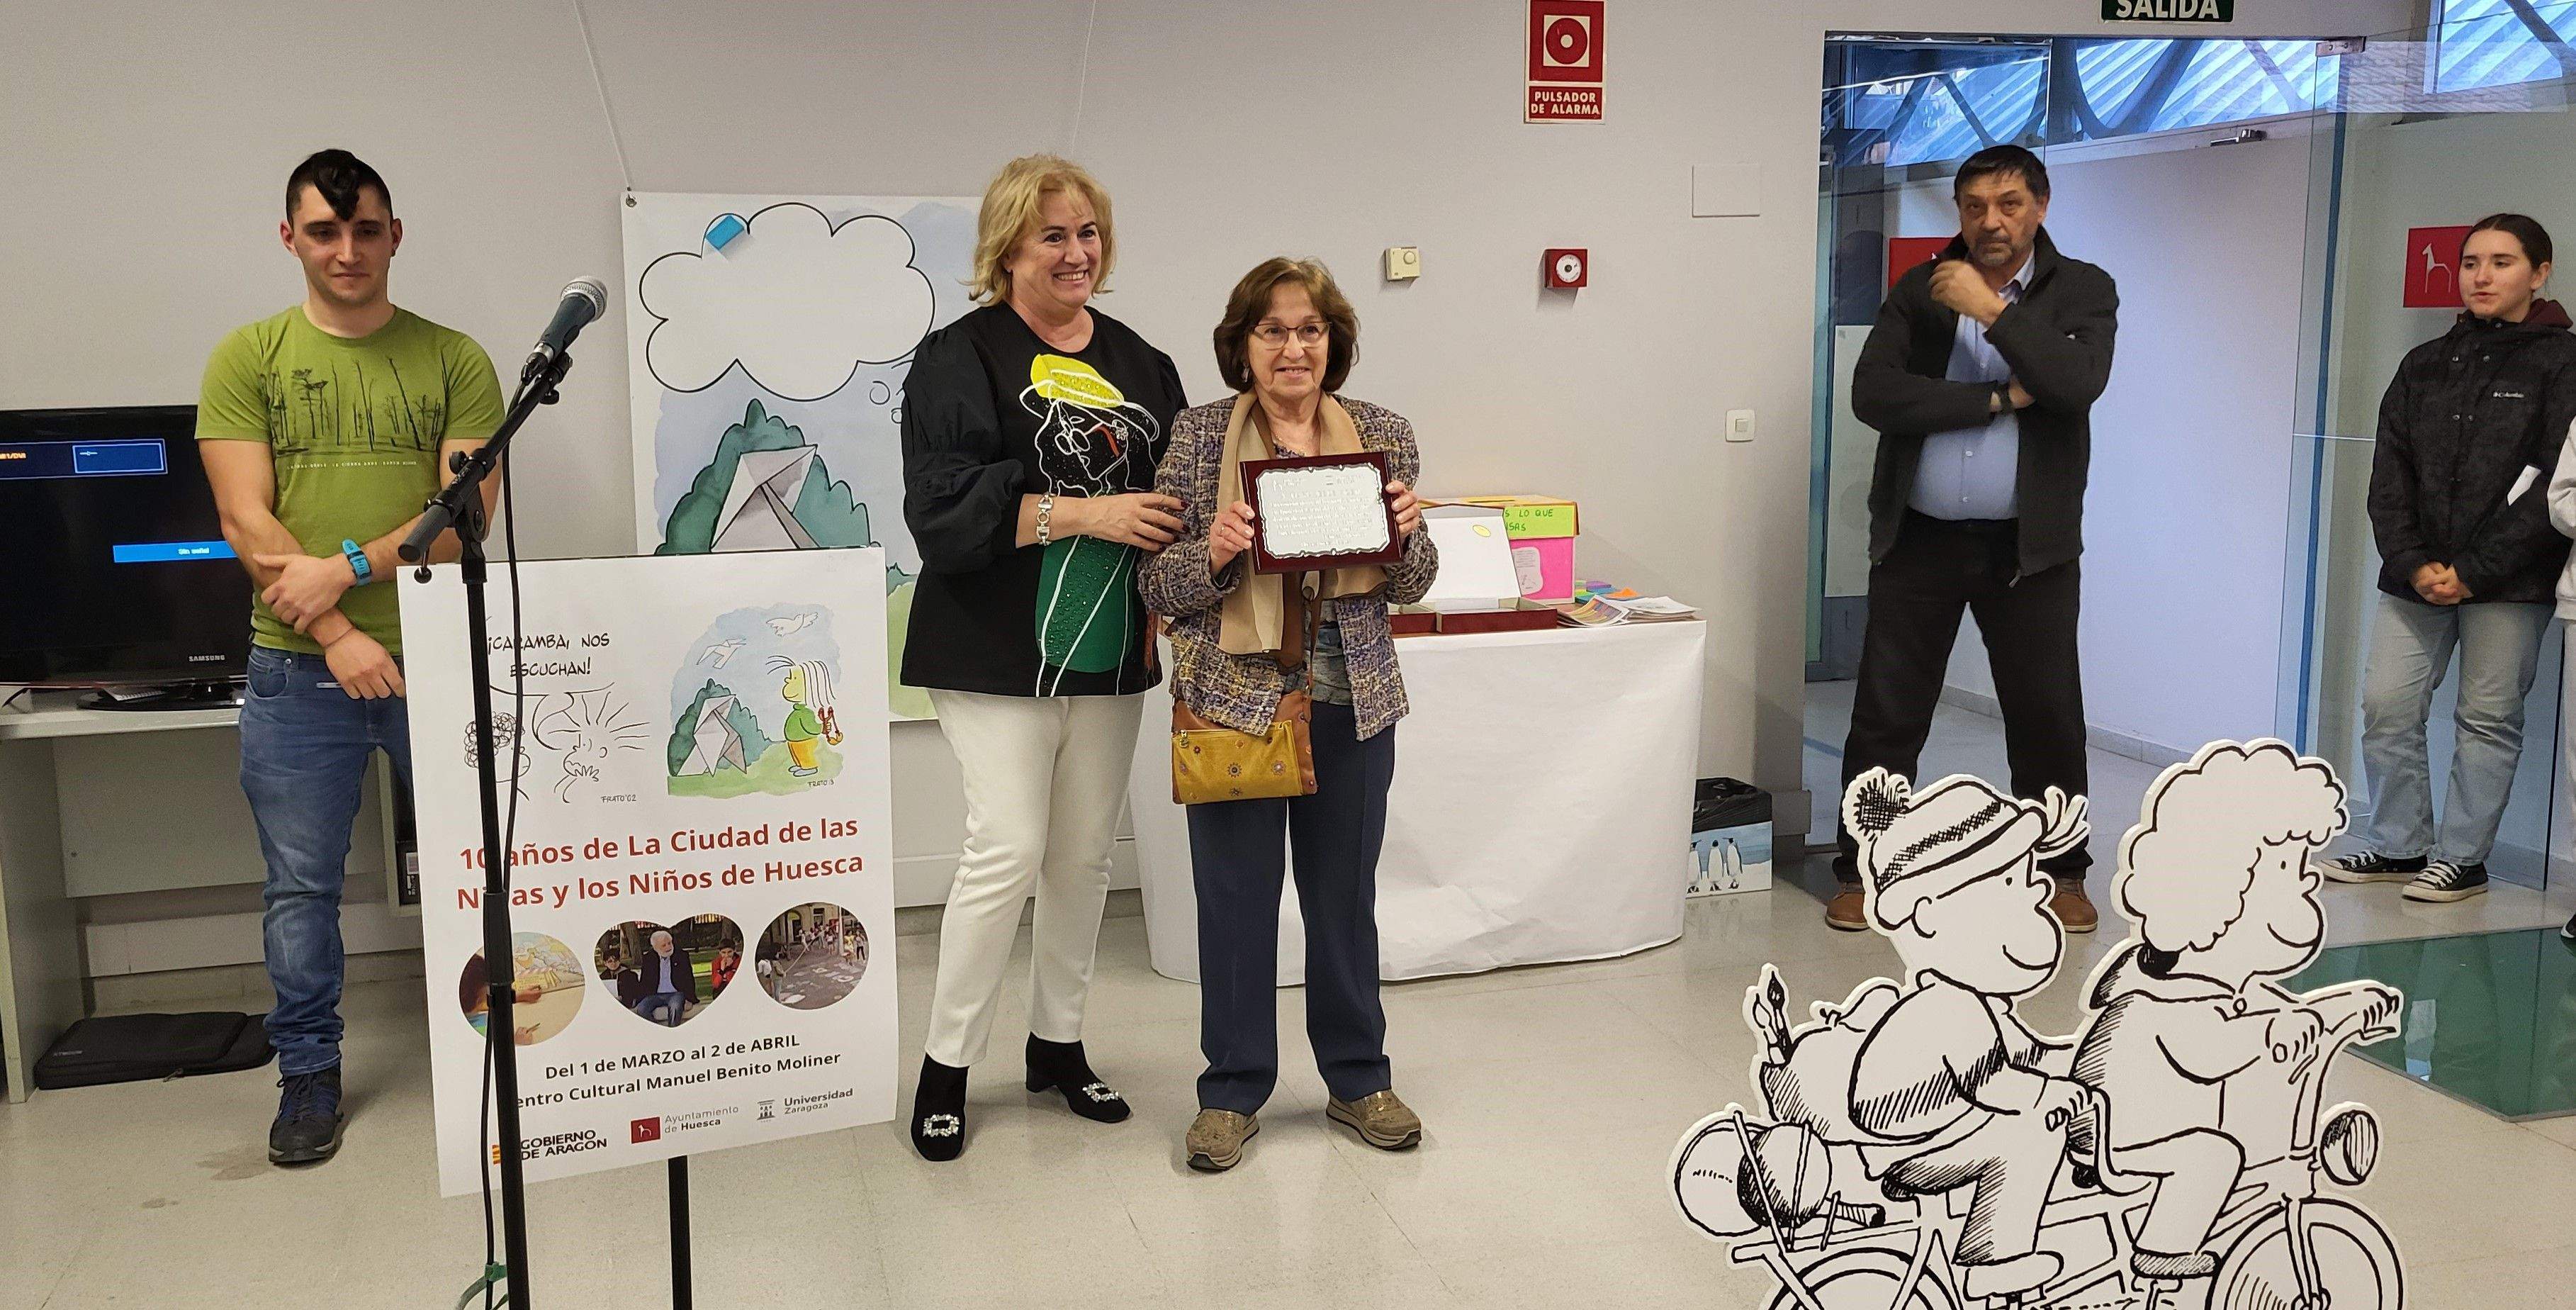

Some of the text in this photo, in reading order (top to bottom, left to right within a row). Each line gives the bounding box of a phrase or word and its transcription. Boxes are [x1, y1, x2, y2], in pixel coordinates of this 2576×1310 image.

[2115, 0, 2220, 18] SALIDA
[1534, 91, 1596, 103] PULSADOR
[1531, 103, 1600, 115] DE ALARMA
[1519, 509, 1530, 517] LO
[1535, 508, 1553, 517] QUE
[581, 632, 610, 648] NOS
[510, 656, 591, 678] ESCUCHAN!
[506, 842, 575, 867] años
[583, 837, 619, 861] de
[629, 835, 661, 856] La
[670, 823, 770, 853] Ciudad
[779, 821, 812, 844] de
[821, 817, 859, 839] las
[457, 855, 863, 909] Nas y los Niños de Huesca
[545, 1034, 801, 1080] Del 1 de MARZO al 2 de ABRIL
[517, 1053, 841, 1109] entro Cultural Manuel Benito Moliner
[784, 1087, 854, 1107] Universidad
[665, 1105, 739, 1124] Ayuntamiento
[784, 1102, 828, 1115] Zaragoza
[664, 1119, 721, 1133] de Huesca
[520, 1129, 597, 1150] GOBIERNO
[521, 1138, 607, 1160] DE ARAGON
